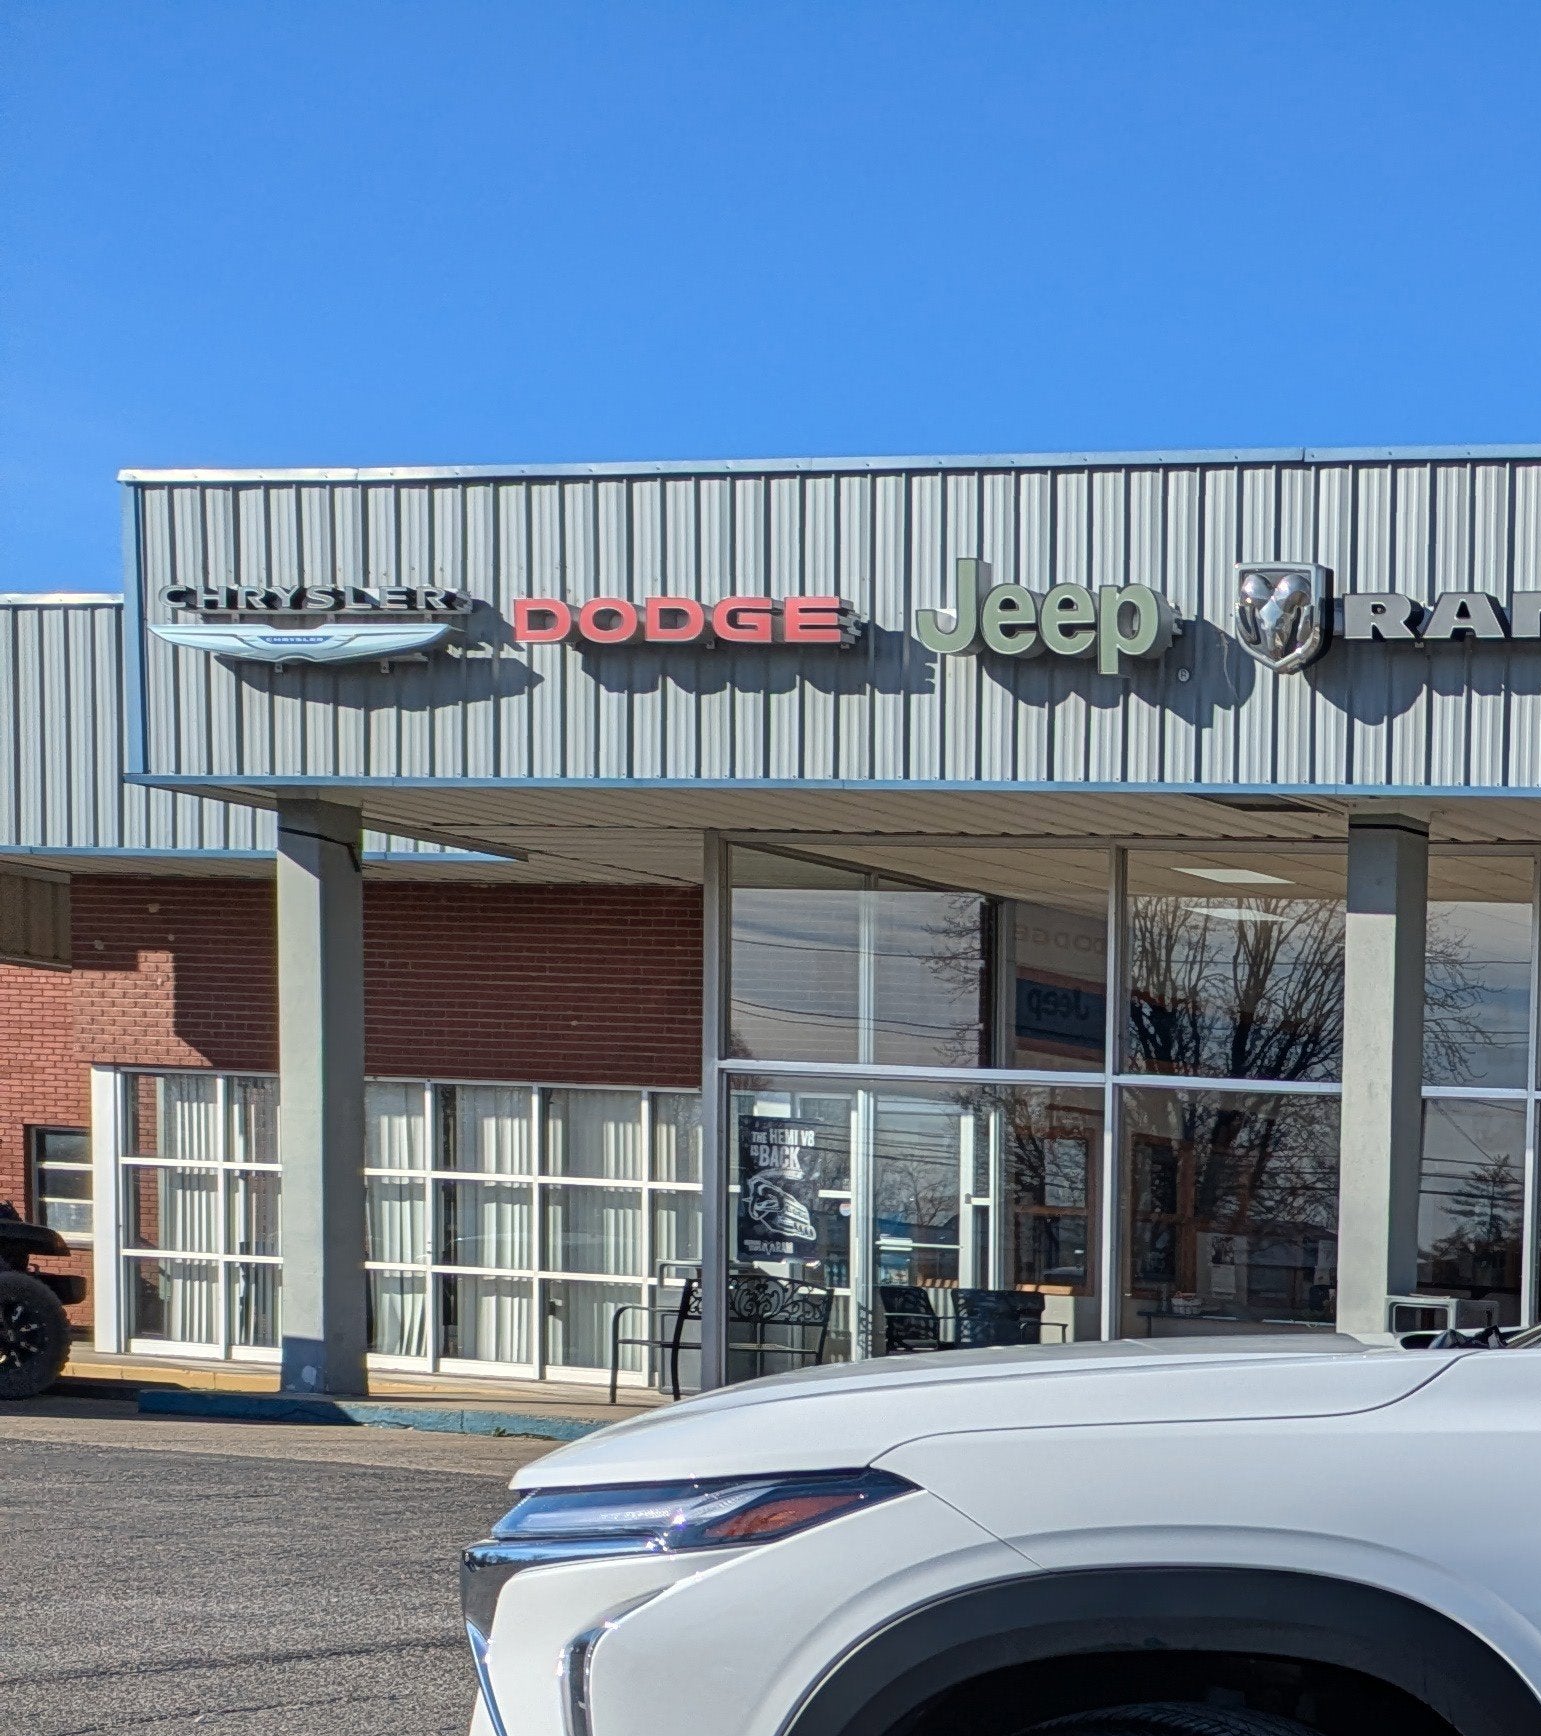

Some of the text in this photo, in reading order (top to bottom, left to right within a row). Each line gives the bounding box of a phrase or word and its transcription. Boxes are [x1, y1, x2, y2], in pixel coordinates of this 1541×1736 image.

[156, 584, 450, 612] CHRYSLER
[514, 596, 842, 644] DODGE
[916, 557, 1162, 675] Jeep
[751, 1128, 815, 1147] THE HEMI V8
[759, 1144, 801, 1170] BACK
